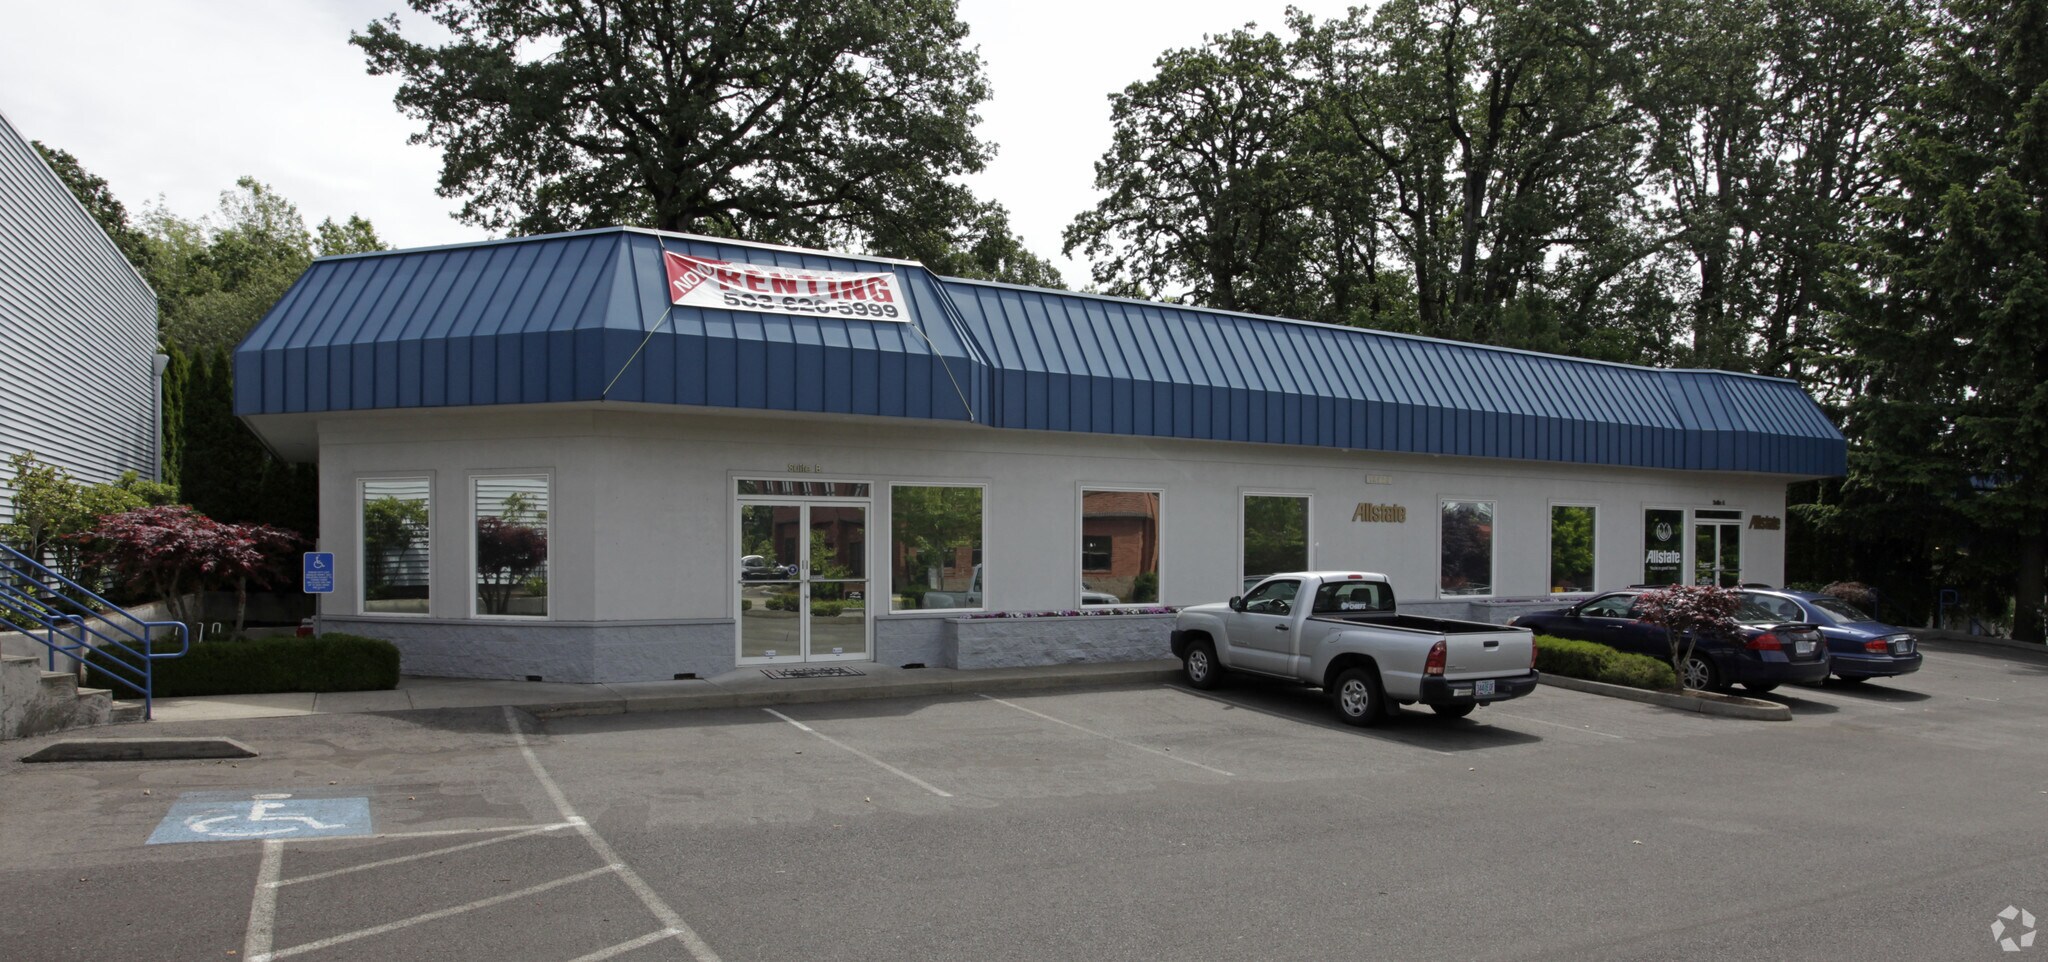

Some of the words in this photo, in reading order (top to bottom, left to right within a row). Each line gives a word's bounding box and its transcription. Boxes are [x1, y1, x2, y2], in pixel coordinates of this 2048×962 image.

[672, 262, 713, 293] NOW
[716, 267, 894, 303] RENTING
[1352, 502, 1407, 523] Allstate
[1645, 549, 1681, 564] Allstate
